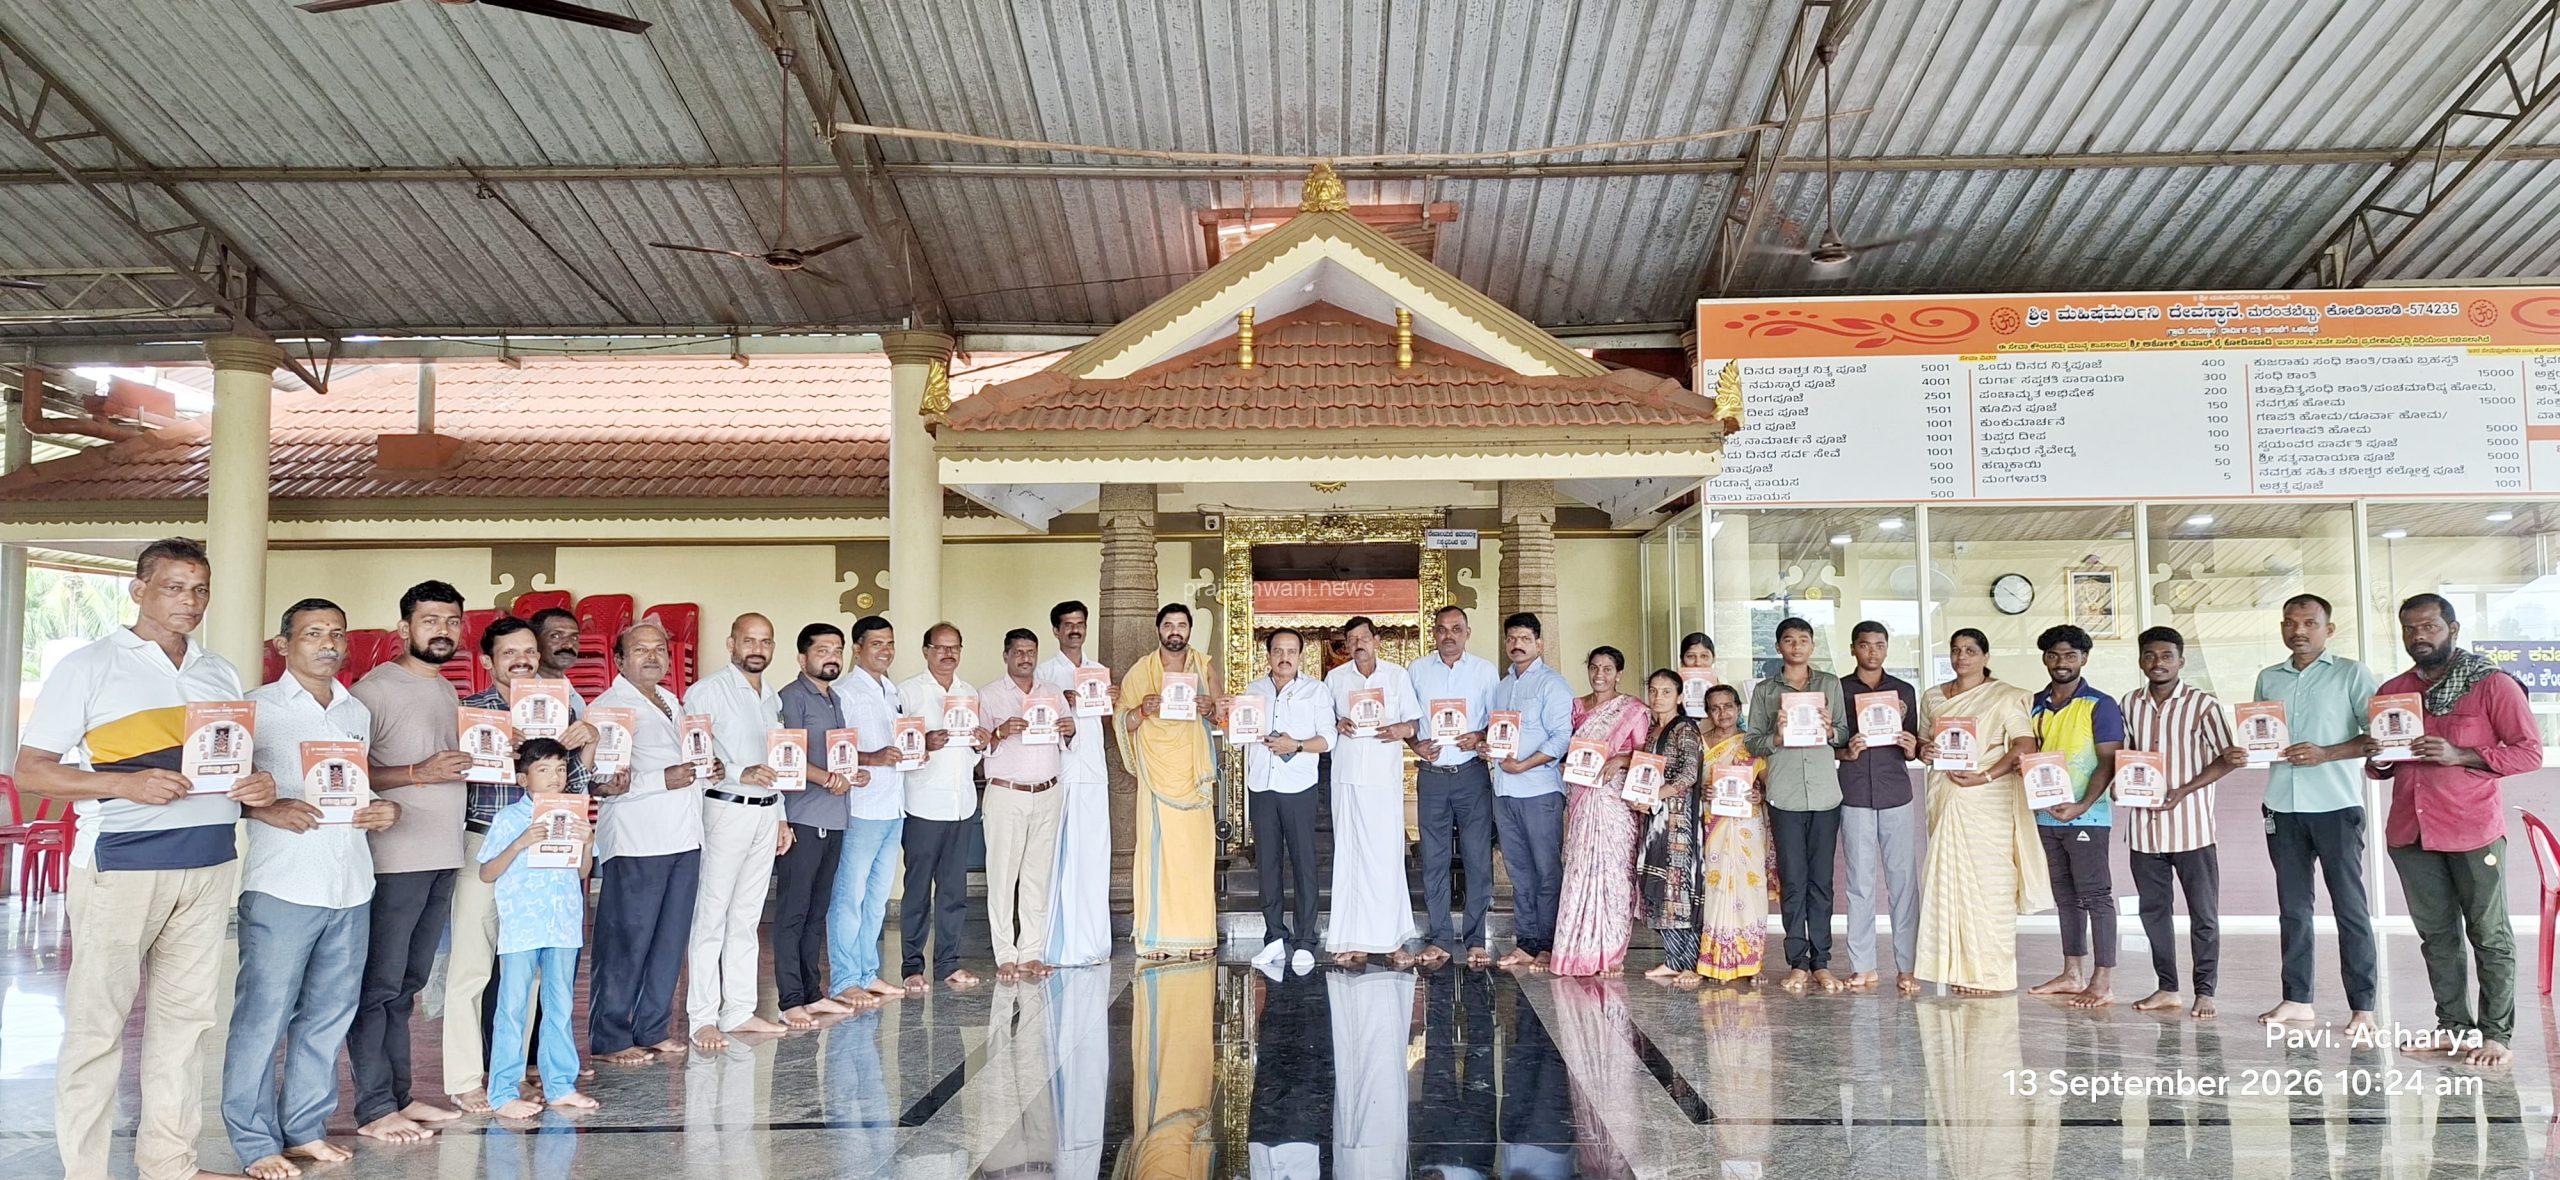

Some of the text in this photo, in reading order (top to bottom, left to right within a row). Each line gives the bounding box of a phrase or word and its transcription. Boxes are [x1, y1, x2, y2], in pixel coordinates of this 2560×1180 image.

[2028, 306, 2048, 326] ಶ್ರೀ
[2057, 305, 2160, 321] ಮಹಿಷಮರ್ದಿನಿ
[1744, 366, 1774, 375] ದಿನದ
[1779, 366, 1809, 377] ಶಾಶ್ವತ
[1813, 366, 1833, 377] ನಿತ್ಯ
[1836, 364, 1867, 374] ಪೂಜೆ
[1978, 362, 2011, 370] ಒಂದು
[2016, 361, 2047, 370] ದಿನದ
[2051, 360, 2102, 372] ನಿತ್ಯಪೂಜೆ
[2063, 374, 2124, 383] ಪಾರಾಯಣ
[2255, 370, 2282, 381] ಸಂಧಿ
[1749, 380, 1800, 391] ನಮಸ್ಕಾರ
[1805, 379, 1835, 389] ಪೂಜೆ
[1748, 392, 1950, 404] ರಂಗಪೂಜೆ 2501
[2045, 388, 2094, 399] ಅಭಿಷೇಕ
[2205, 387, 2227, 395] 200
[1980, 401, 2227, 413] ಹೂವಿನ ಪೂಜೆ 150
[2256, 399, 2298, 409] ನವಗ್ರಹ
[2303, 398, 2345, 406] ಹೋಮ
[1747, 408, 1774, 416] ದೀಪ
[1778, 407, 1808, 417] ಪೂಜೆ
[2257, 413, 2295, 421] ಗಣಪತಿ
[2399, 410, 2447, 419] ಹೋಮ/
[1765, 421, 1796, 432] ಪೂಜೆ
[1927, 420, 1951, 428] 1001
[1980, 416, 2065, 427] ಕುಂಕುಮಾರ್ಚನೆ
[2257, 426, 2324, 434] ಬಾಲಗಣಪತಿ
[2329, 425, 2371, 433] ಹೋಮ
[1745, 435, 1812, 445] ನಾಮಾರ್ಚನೆ
[1816, 434, 1847, 445] ಪೂಜೆ
[1927, 434, 1952, 442] 1001
[2019, 432, 2046, 440] ದೀಪ
[2258, 440, 2313, 452] ಸ್ವಯಂವರ
[2367, 438, 2397, 448] ಪೂಜೆ
[2487, 438, 2518, 446] 5000
[1746, 450, 1776, 459] ದಿನದ
[1781, 450, 1809, 458] ಸರ್ವ
[1814, 448, 1840, 458] ಸೇವೆ
[1927, 448, 1952, 456] 1001
[2259, 454, 2274, 463] ಶ್ರೀ
[2278, 454, 2359, 465] ಸತ್ಯನಾರಾಯಣ
[2364, 452, 2395, 462] ಪೂಜೆ
[1721, 462, 1953, 474] ಹಾಪೂಜೆ 500
[2260, 468, 2301, 478] ನವಗ್ರಹ
[2433, 465, 2464, 475] ಪೂಜೆ
[1755, 478, 1799, 486] ಪಾಯಸ
[2293, 481, 2323, 491] ಪೂಜೆ
[1746, 492, 1790, 503] ಪಾಯಸ
[1931, 491, 1954, 500] 500
[2539, 668, 2560, 687] ಕೌಂ
